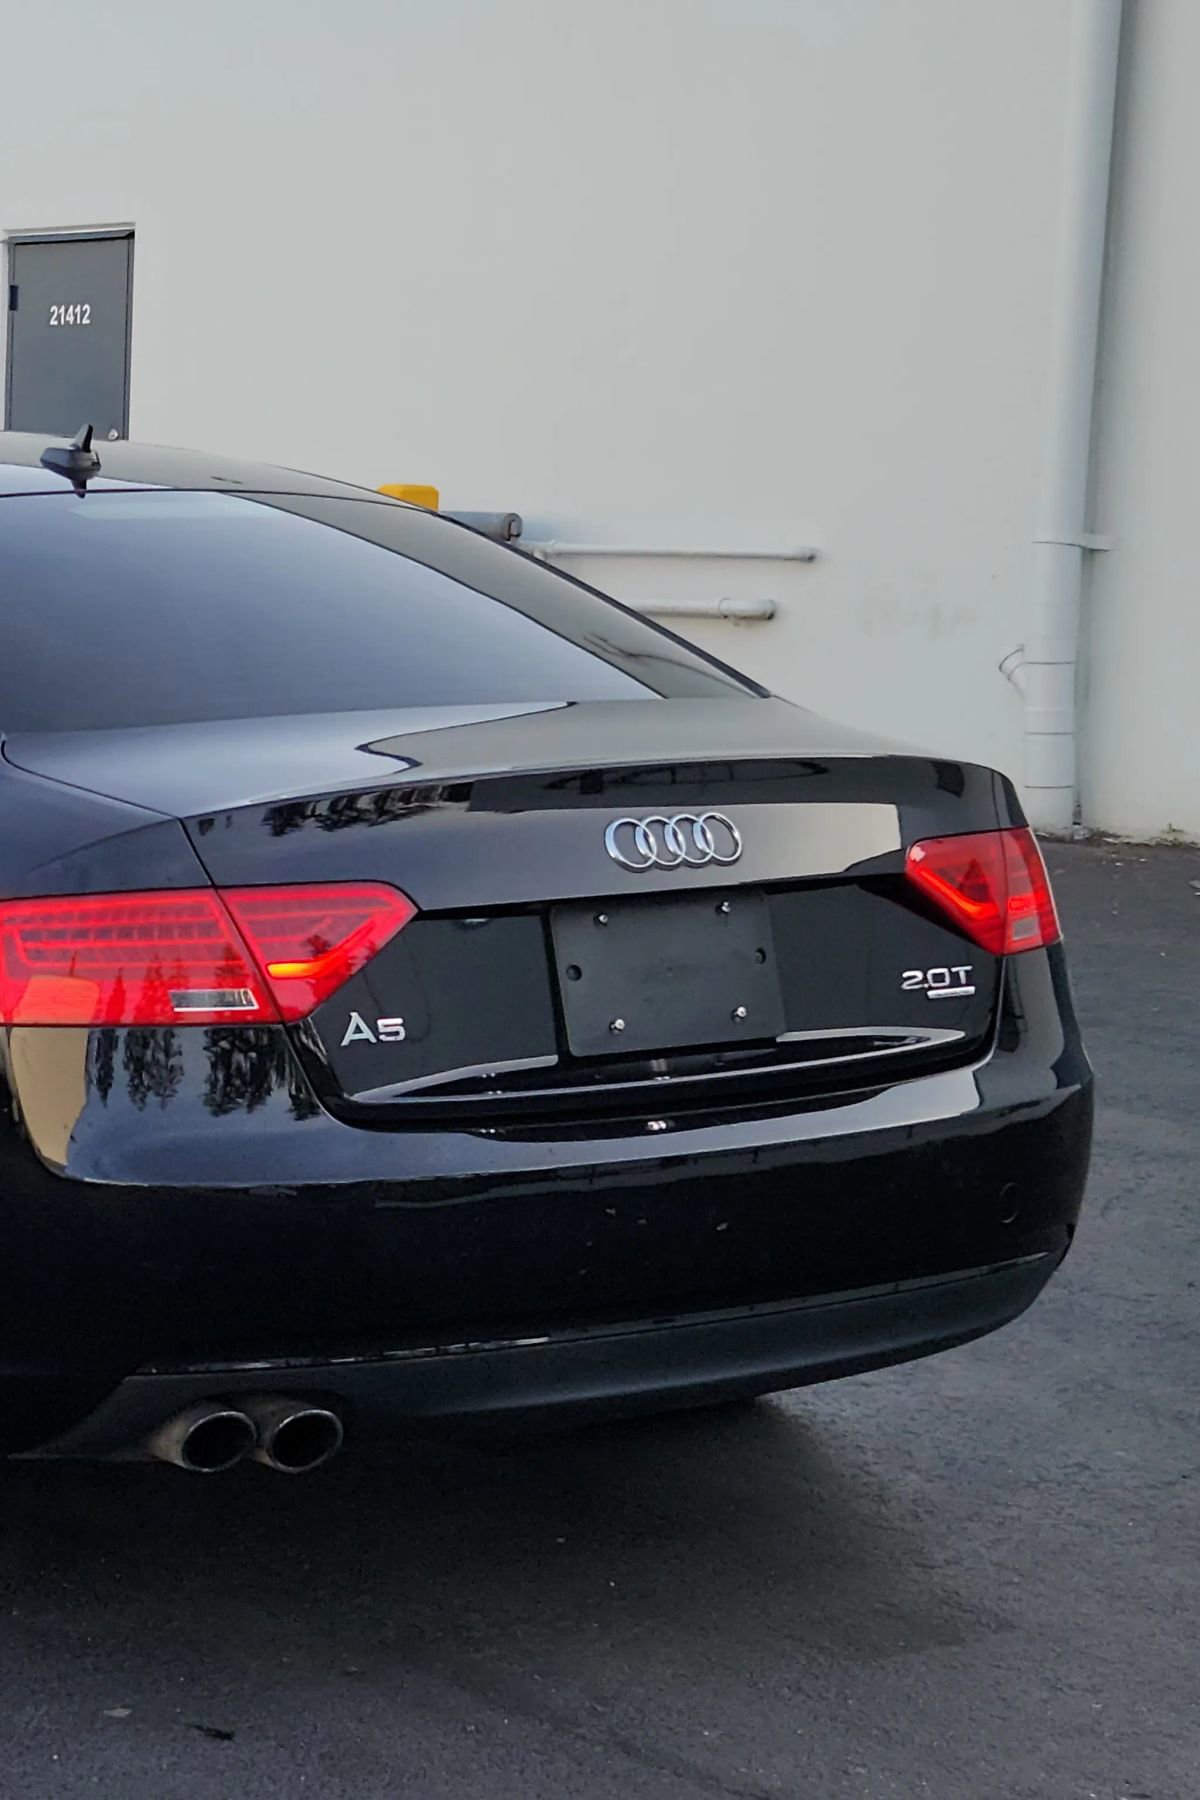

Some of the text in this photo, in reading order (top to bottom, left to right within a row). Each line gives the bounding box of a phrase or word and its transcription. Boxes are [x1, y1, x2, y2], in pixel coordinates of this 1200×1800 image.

[49, 304, 91, 325] 21412
[901, 965, 973, 990] 2.0T
[340, 1011, 406, 1047] A5
